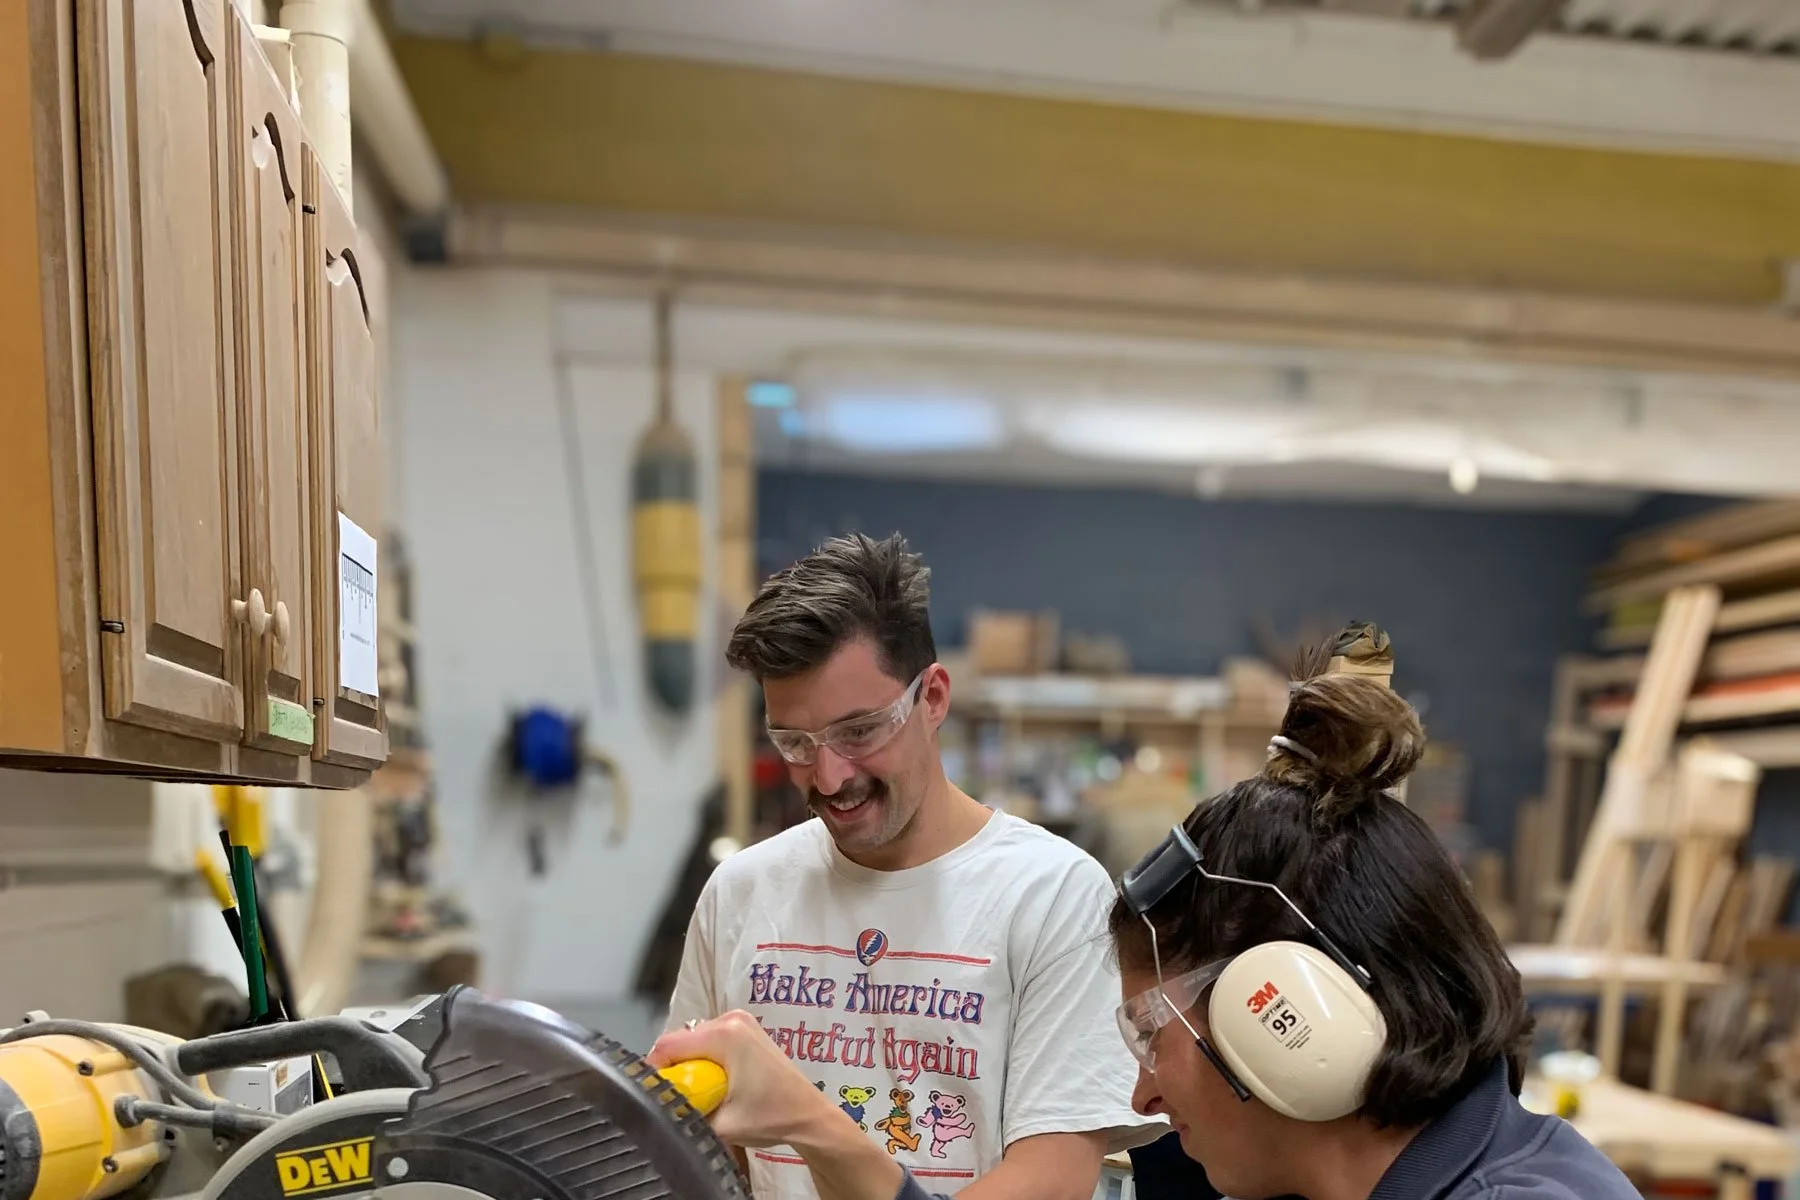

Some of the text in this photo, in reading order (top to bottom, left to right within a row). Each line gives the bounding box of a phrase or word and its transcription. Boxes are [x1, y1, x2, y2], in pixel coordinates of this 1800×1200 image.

[748, 963, 985, 1025] Make America
[1247, 981, 1279, 1014] 3M
[1272, 1009, 1297, 1036] 95
[882, 1026, 980, 1085] Again
